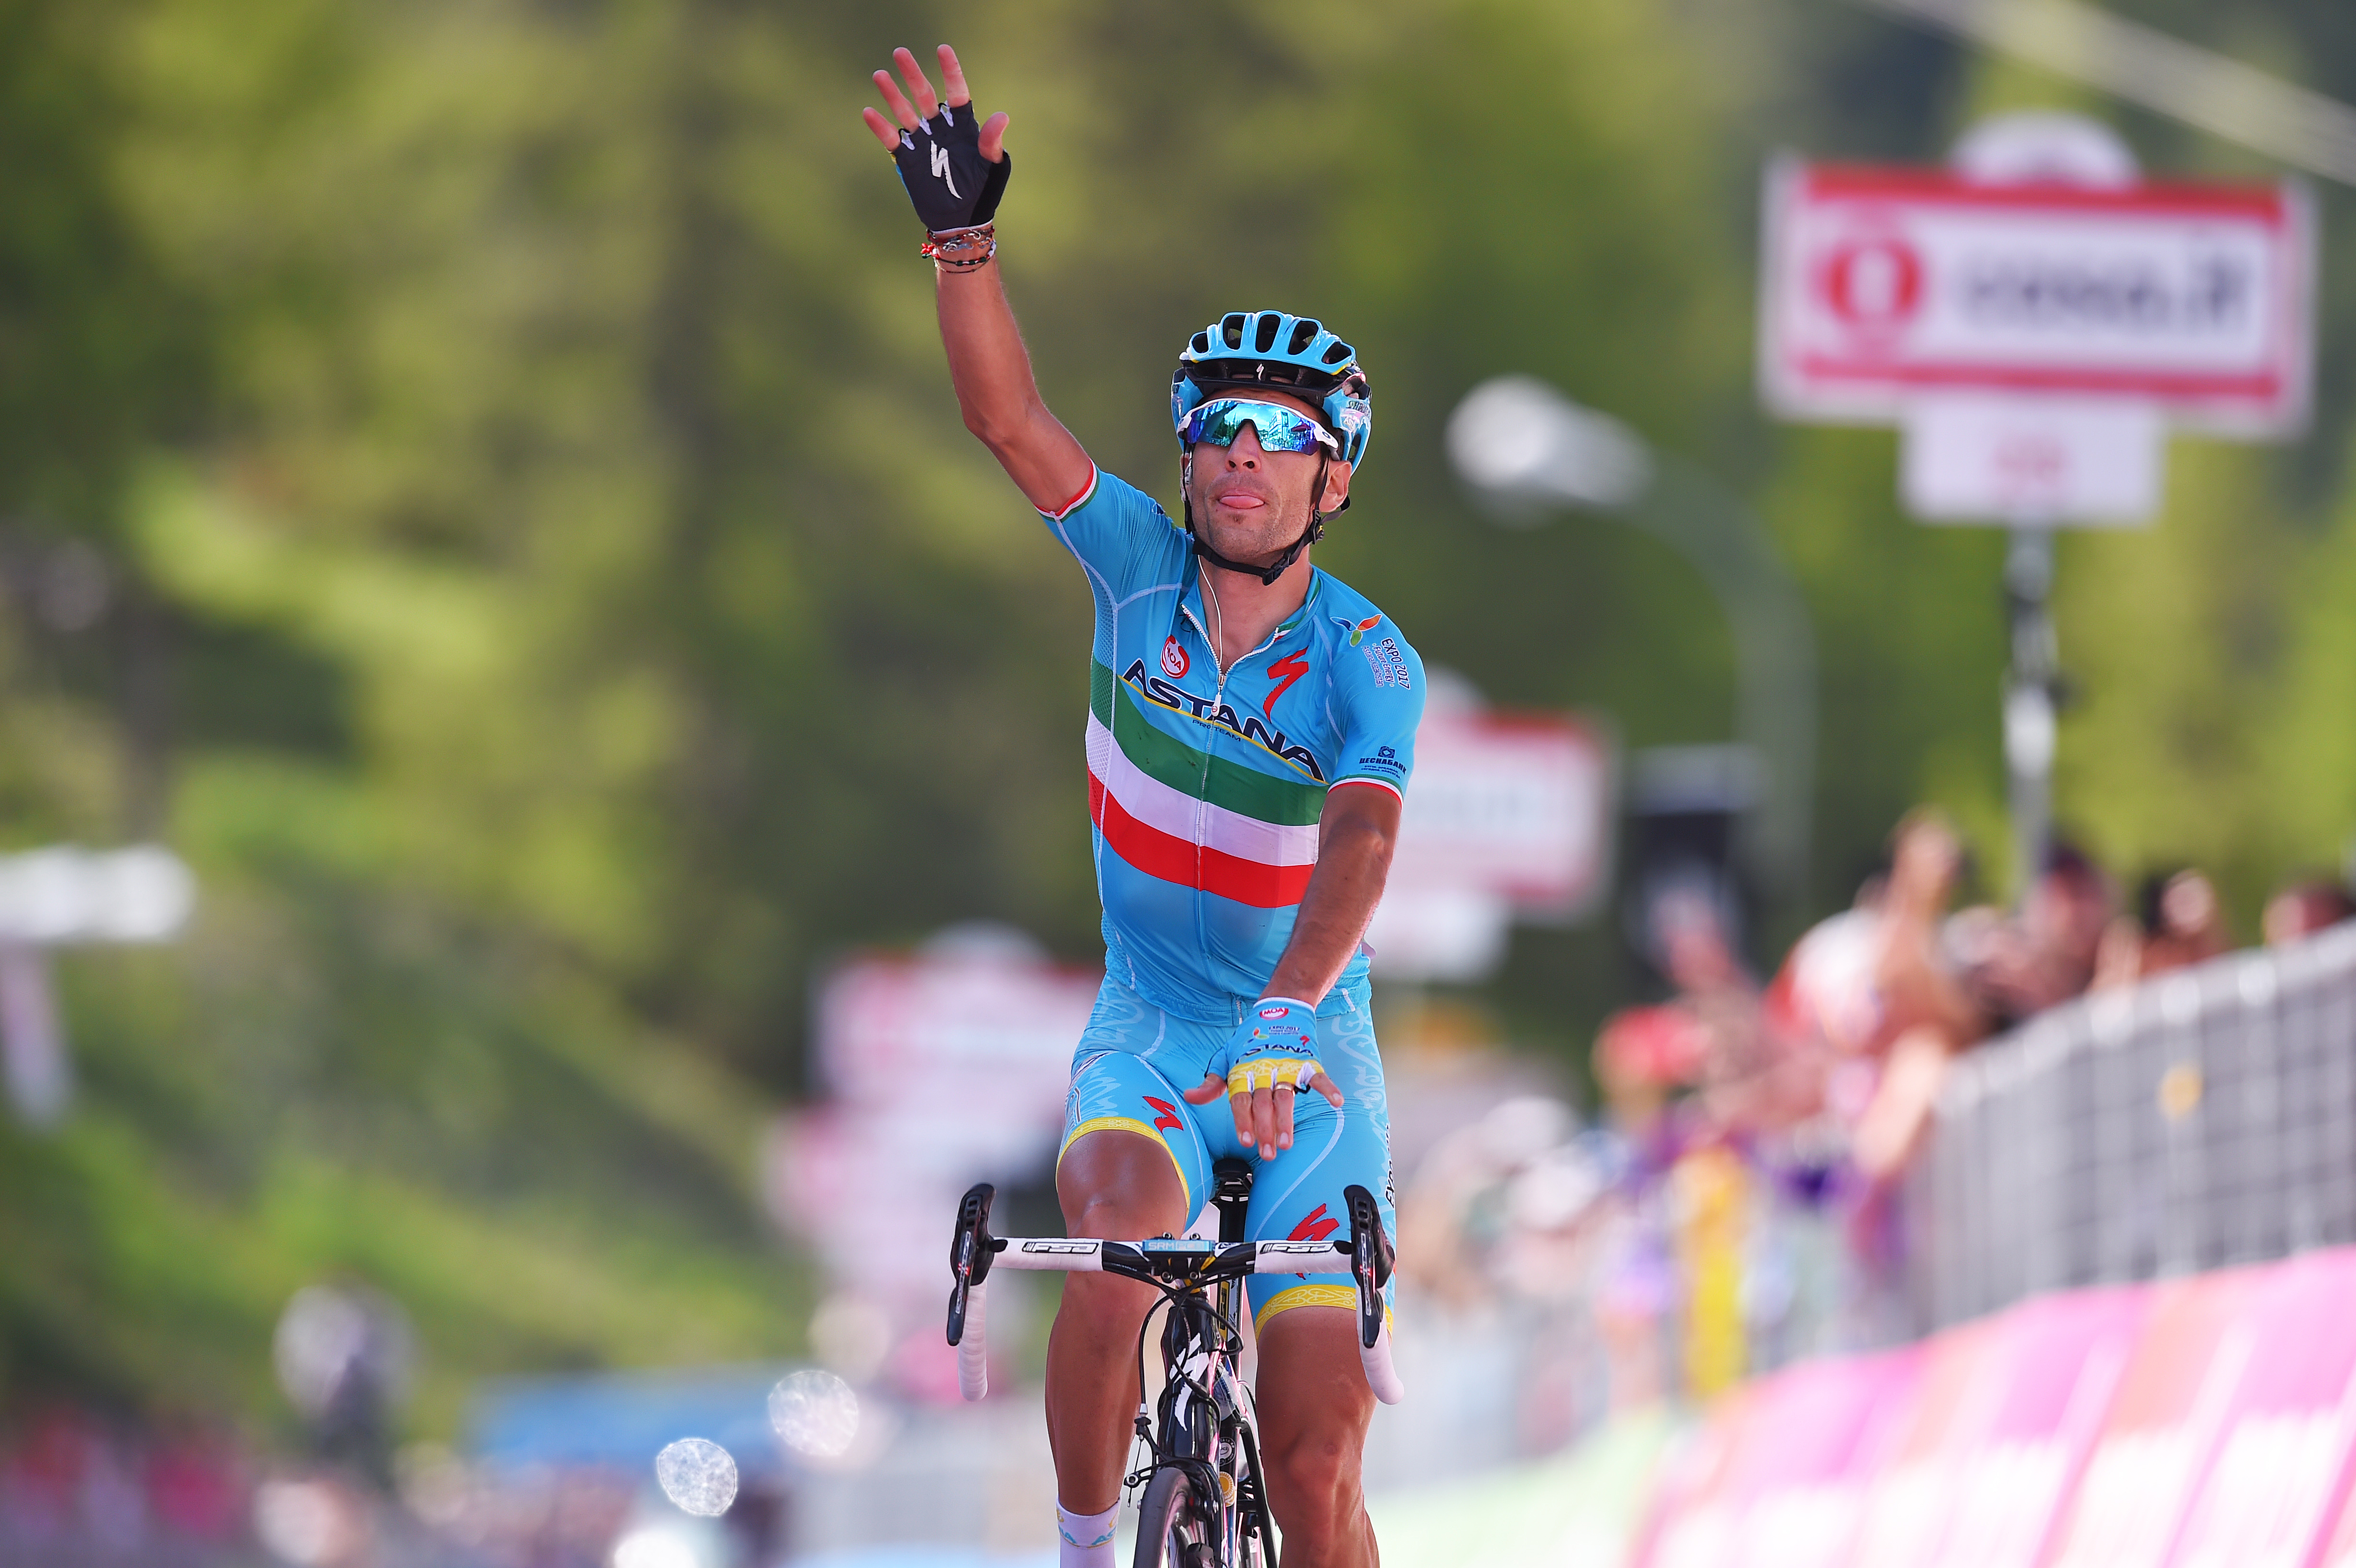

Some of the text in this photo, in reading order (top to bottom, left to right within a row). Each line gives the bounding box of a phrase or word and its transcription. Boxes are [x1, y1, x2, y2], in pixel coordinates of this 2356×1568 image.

[1362, 646, 1375, 662] Astana
[1381, 638, 1410, 689] EXPO 2017
[1373, 646, 1395, 683] Future Energy
[1122, 659, 1325, 782] ASTANA
[1192, 719, 1241, 742] PRO TEAM
[1264, 1007, 1284, 1015] MOA
[1026, 1243, 1097, 1253] FSA
[1265, 1243, 1333, 1252] FSA
